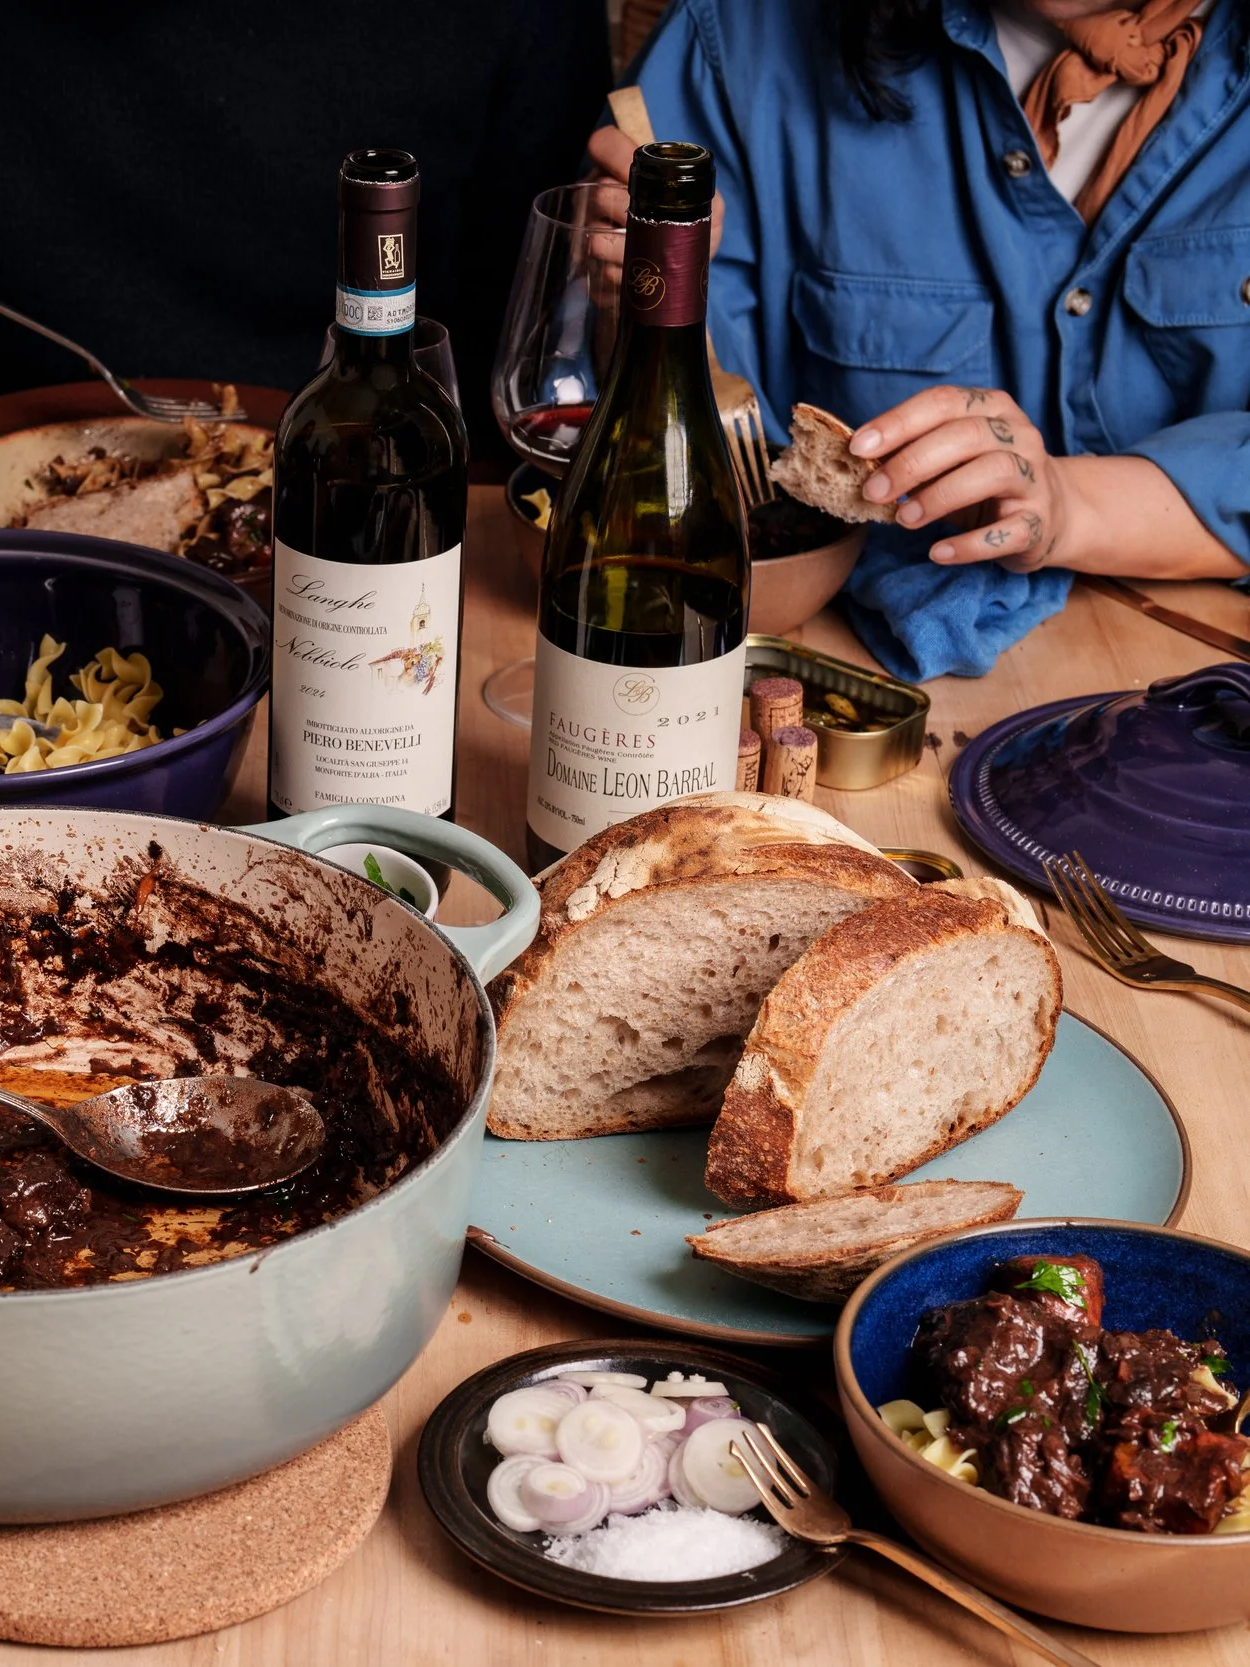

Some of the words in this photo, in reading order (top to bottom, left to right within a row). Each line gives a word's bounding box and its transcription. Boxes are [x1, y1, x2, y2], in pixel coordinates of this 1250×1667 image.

[344, 303, 360, 320] DOC
[285, 574, 378, 613] Langhe
[319, 620, 343, 633] ORIGINE
[343, 625, 388, 635] CONTROLLATA
[276, 635, 367, 671] Nebbiolo
[300, 684, 326, 699] 2024
[657, 706, 720, 728] 2021
[306, 719, 359, 734] IMBOTTIGLIATO
[404, 724, 415, 732] DA
[550, 711, 656, 749] FAUGÈRES
[303, 729, 342, 750] PIERO
[346, 733, 422, 752] BENEVELLI
[560, 743, 596, 760] FAUGÈRES
[597, 755, 618, 764] WINE
[581, 744, 615, 757] Faugères
[617, 751, 655, 759] Contrôlée
[314, 765, 352, 778] MONFORTE
[385, 769, 408, 778] ITALIA
[366, 759, 400, 768] GIUSEPPE
[602, 767, 651, 799] LEON
[656, 761, 717, 798] BARRAL
[314, 790, 354, 803] FAMIGLIA
[356, 794, 406, 804] CONTADINA
